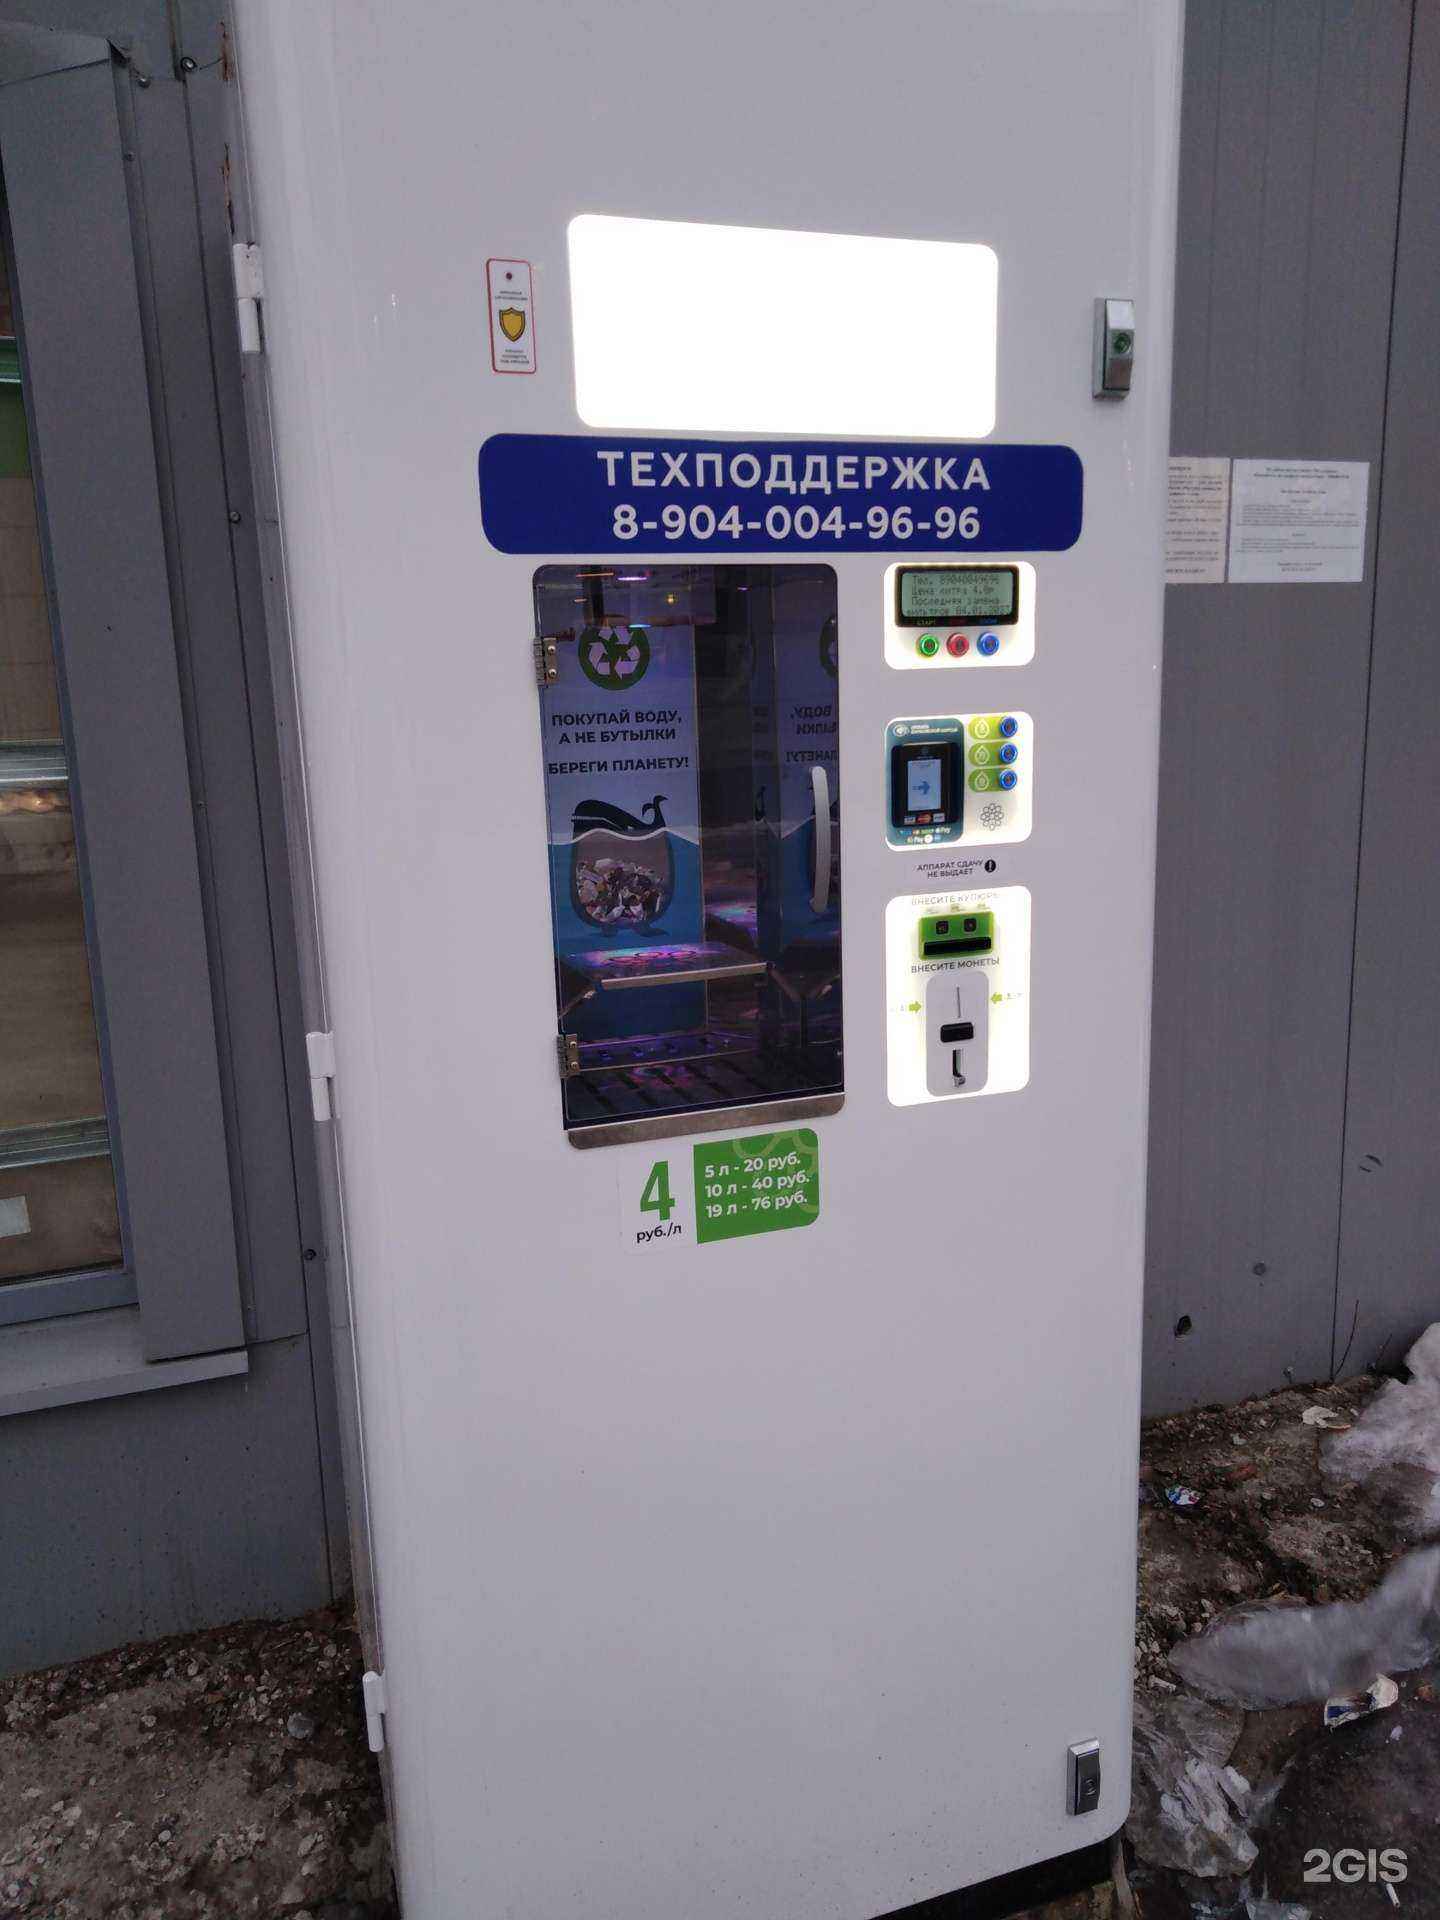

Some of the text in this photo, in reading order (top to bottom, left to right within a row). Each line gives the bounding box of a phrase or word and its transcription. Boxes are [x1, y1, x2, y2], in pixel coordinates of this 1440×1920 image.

[596, 450, 991, 495] ТЕХПОДДЕРЖКА
[612, 503, 980, 540] 8-904-004-96-96
[552, 709, 682, 726] ПОКУПАЙ ВОДУ,
[559, 728, 676, 744] А НЕ БУТЫЛКИ
[548, 757, 689, 774] БЕРЕГИ ПЛАНЕТУ!
[917, 859, 983, 871] АППАРАТ СДАЧУ
[928, 868, 973, 878] НЕ ВЫДАЕТ
[911, 957, 1000, 974] ВНЕСИТЕ МОНЕТЫ
[704, 1165, 715, 1178] 5
[718, 1163, 730, 1177] л
[743, 1158, 763, 1173] 20
[768, 1151, 801, 1171] руб.
[640, 1159, 676, 1221] 4
[705, 1184, 722, 1198] 10
[726, 1182, 737, 1195] л
[752, 1176, 773, 1190] 40
[777, 1170, 810, 1189] руб.
[705, 1204, 722, 1219] 19
[726, 1203, 737, 1215] л
[751, 1197, 771, 1211] 76
[775, 1191, 808, 1210] руб.
[636, 1222, 682, 1243] руб./л
